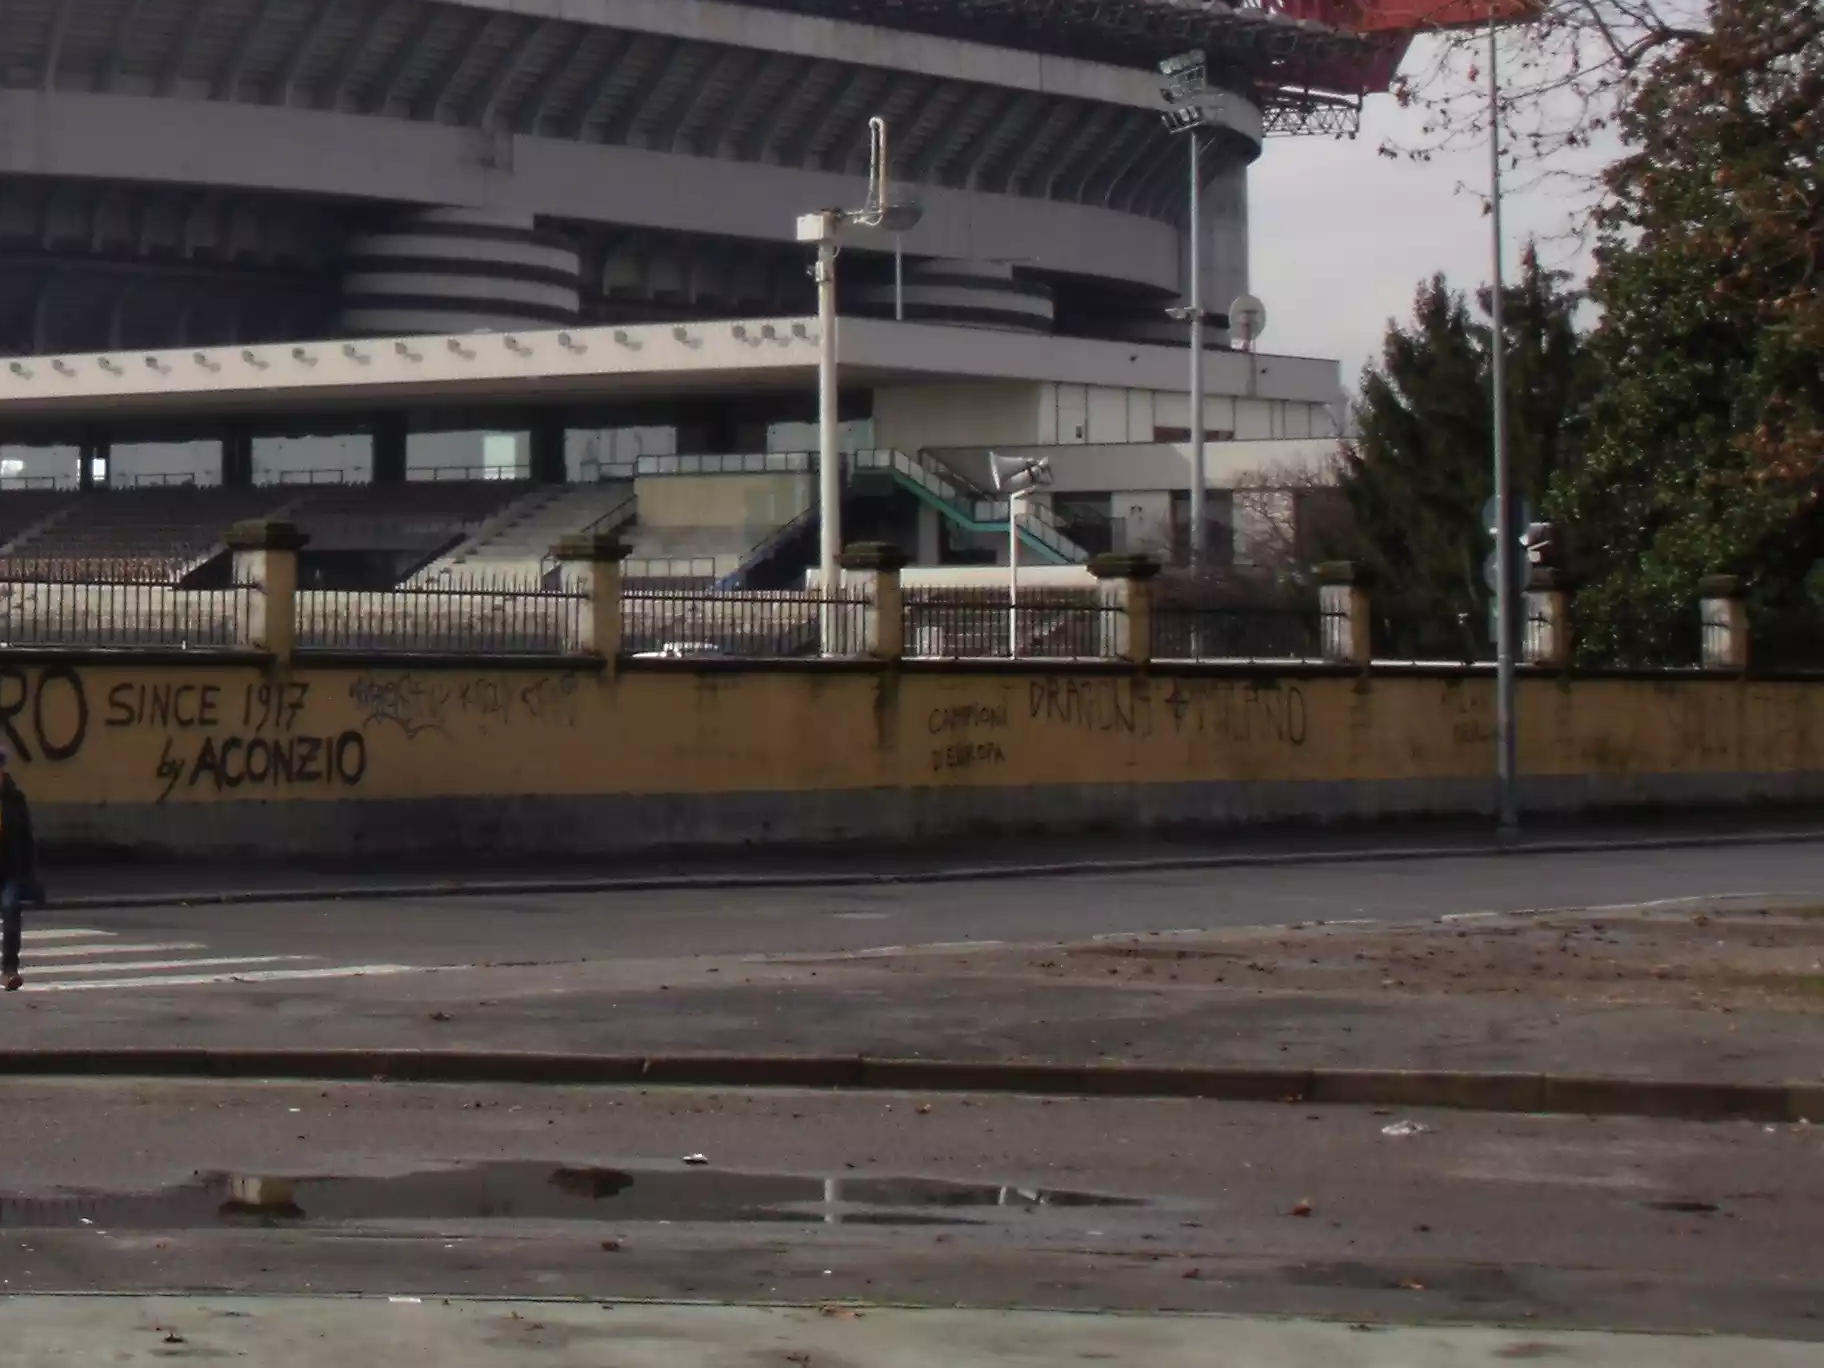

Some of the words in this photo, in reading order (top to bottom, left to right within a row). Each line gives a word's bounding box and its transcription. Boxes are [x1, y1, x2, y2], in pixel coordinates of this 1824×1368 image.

[104, 682, 222, 728] SINCE
[242, 681, 310, 733] 1917
[187, 730, 367, 792] ACONZIO
